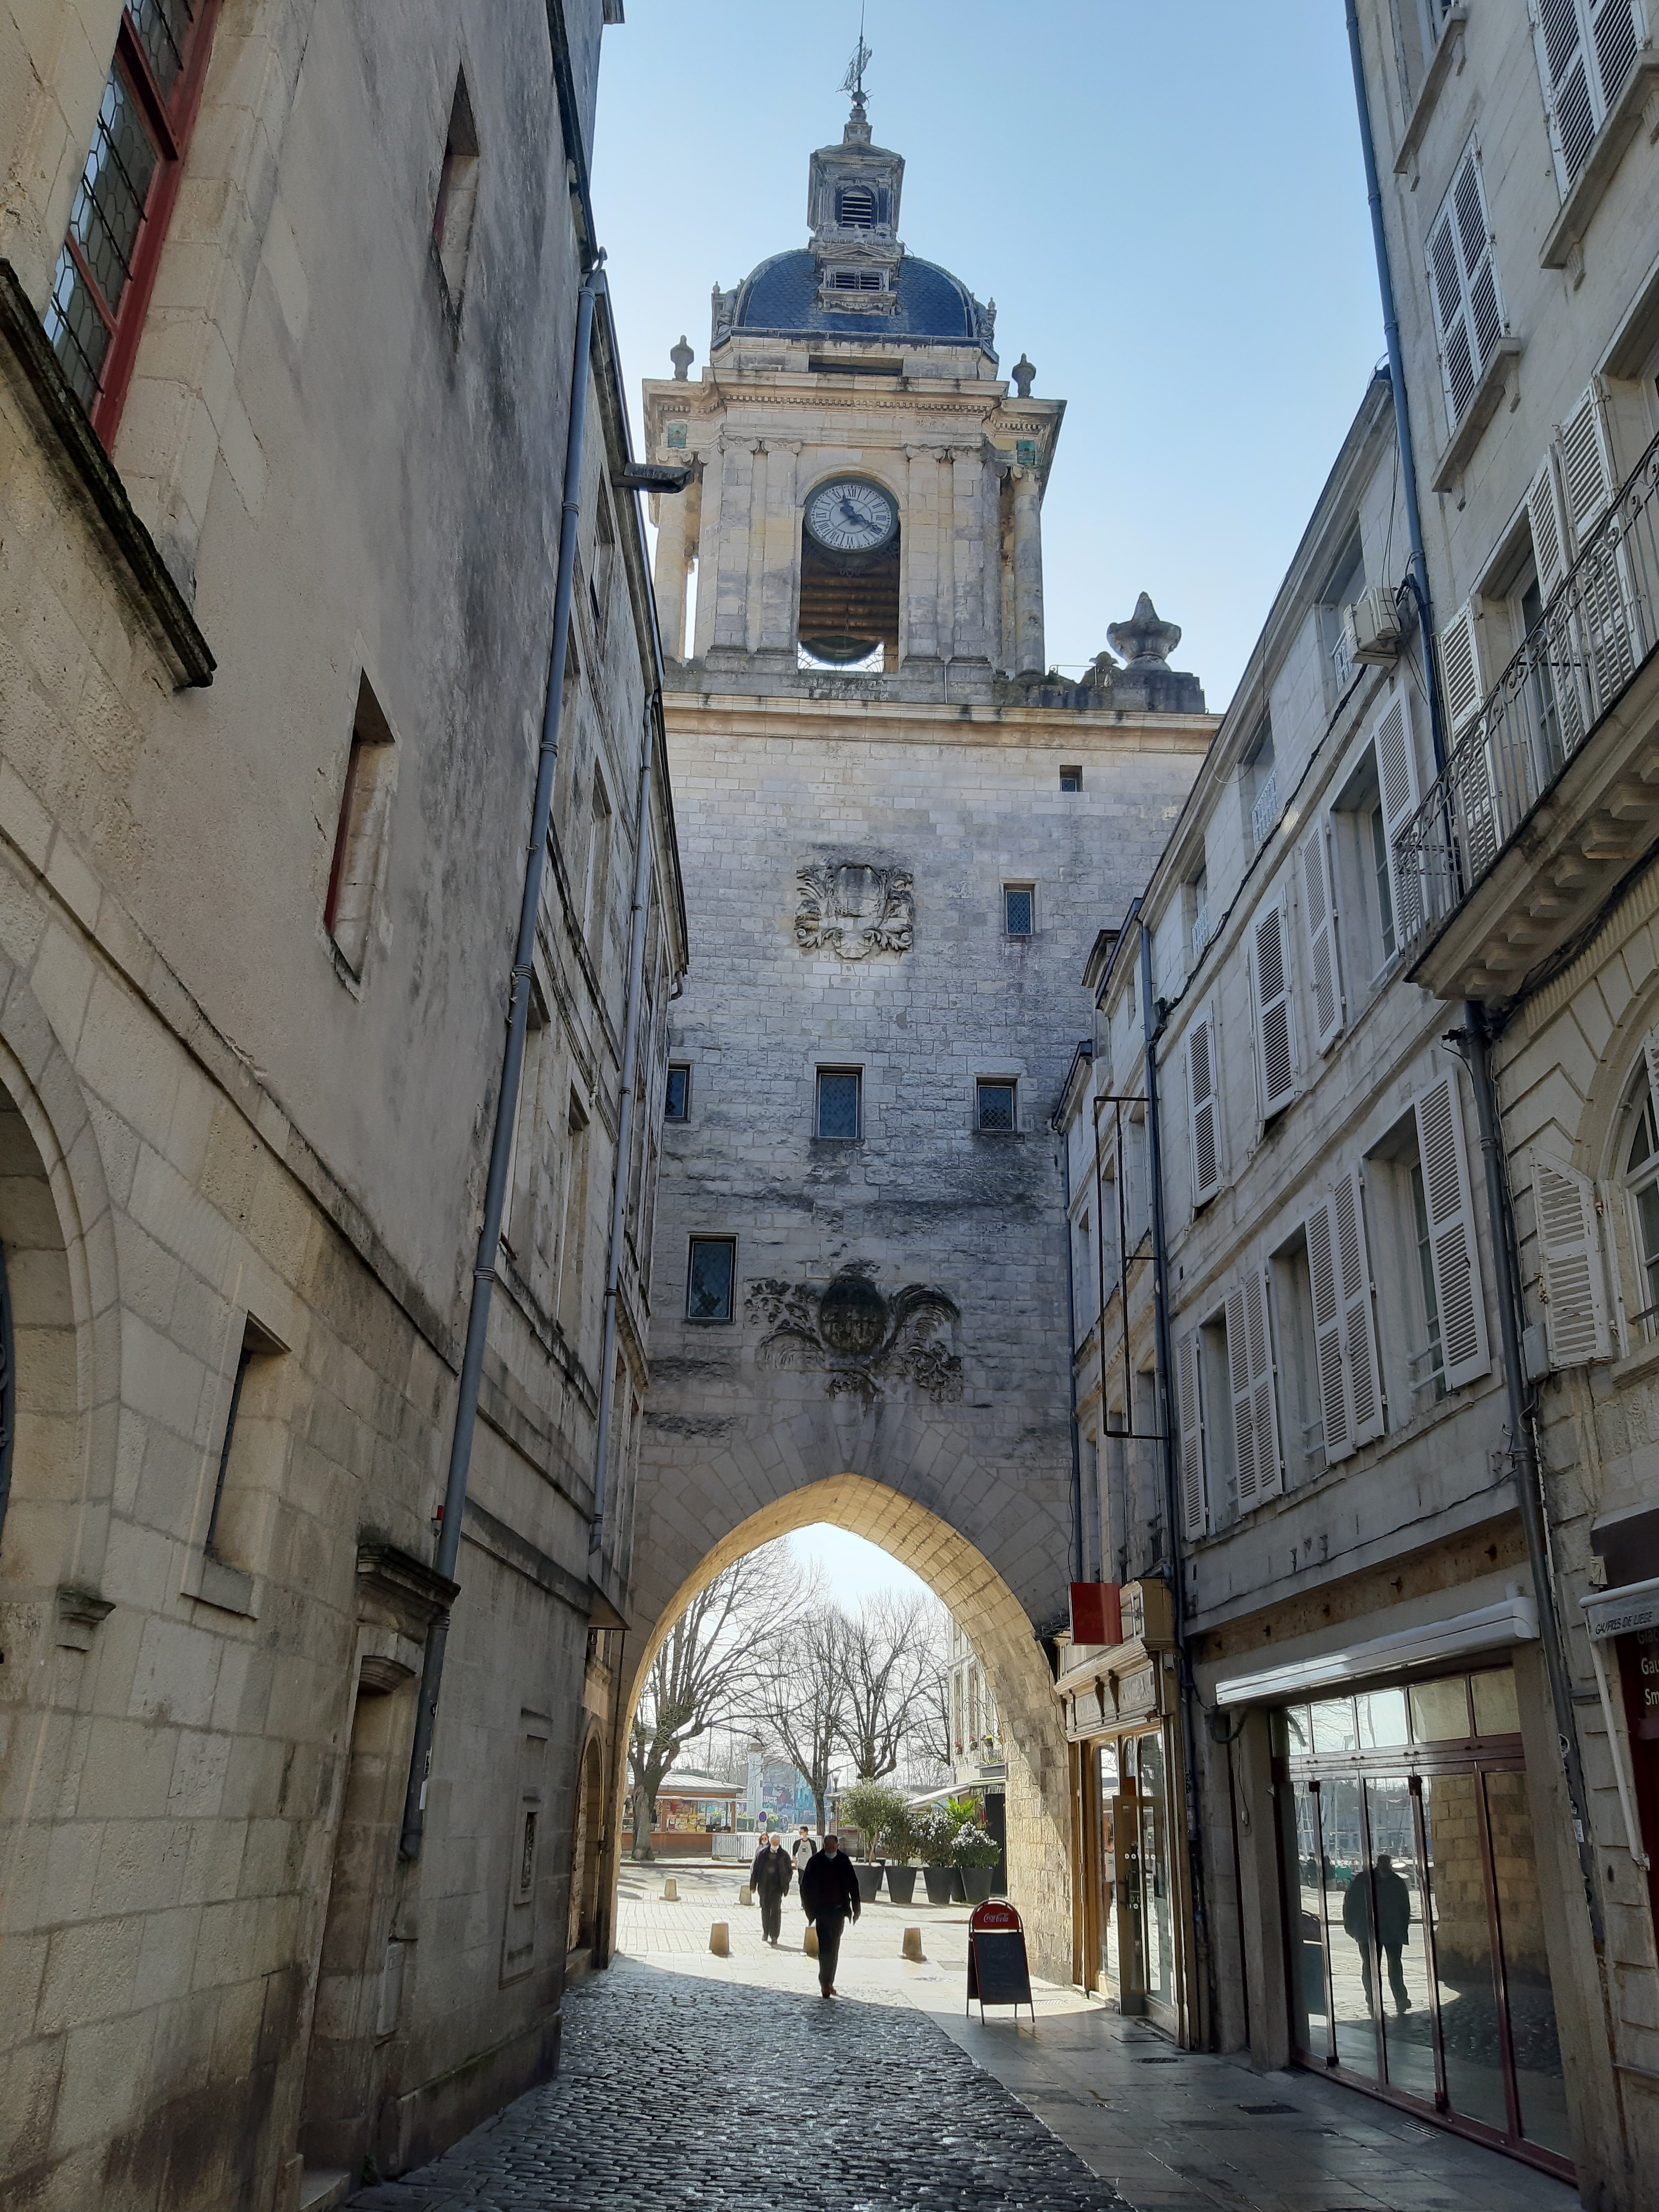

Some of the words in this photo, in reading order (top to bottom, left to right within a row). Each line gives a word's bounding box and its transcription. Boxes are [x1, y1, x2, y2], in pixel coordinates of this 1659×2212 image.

[1596, 1618, 1621, 1635] GAUFRES
[1622, 1615, 1633, 1628] DE
[983, 1912, 1010, 1923] CocaCola
